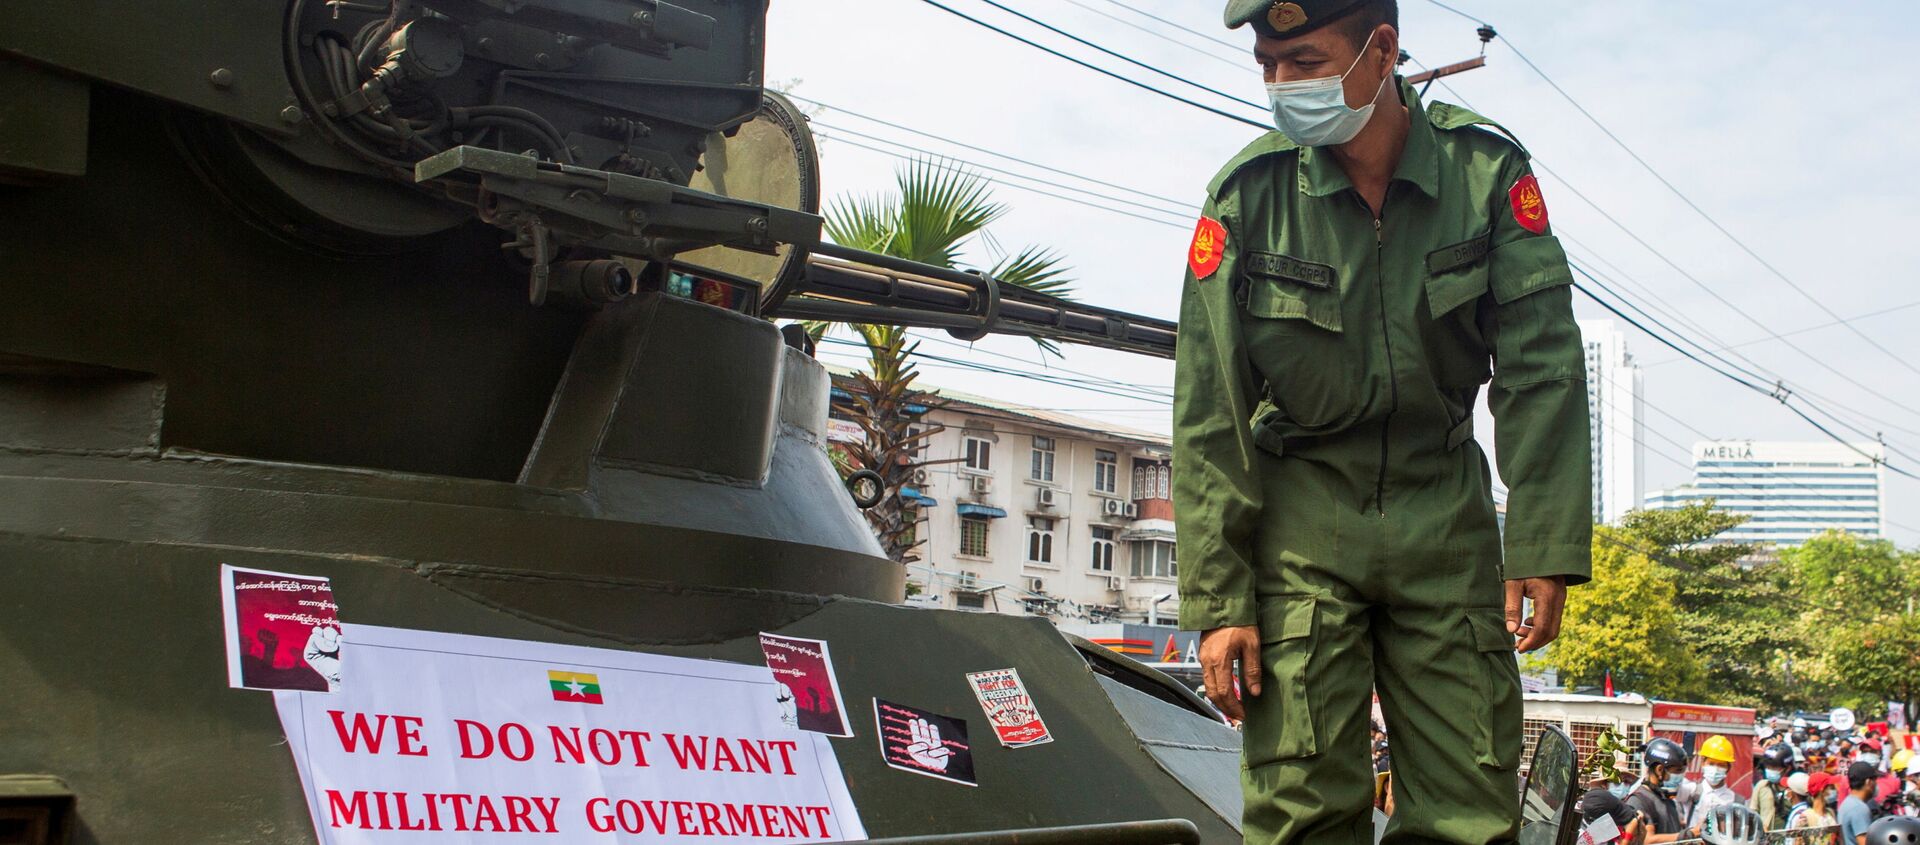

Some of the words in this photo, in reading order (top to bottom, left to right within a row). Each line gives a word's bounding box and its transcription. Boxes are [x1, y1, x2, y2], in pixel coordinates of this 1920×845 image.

[1293, 263, 1326, 283] CORPS
[978, 681, 1000, 691] FIGHT
[1001, 680, 1016, 688] FOR
[982, 688, 1021, 700] FREEDOM
[329, 711, 428, 756] WE
[457, 720, 534, 761] DO
[549, 726, 651, 766] NOT
[665, 734, 796, 775] WANT
[327, 790, 559, 833] MILITARY
[585, 797, 830, 838] GOVERMENT
